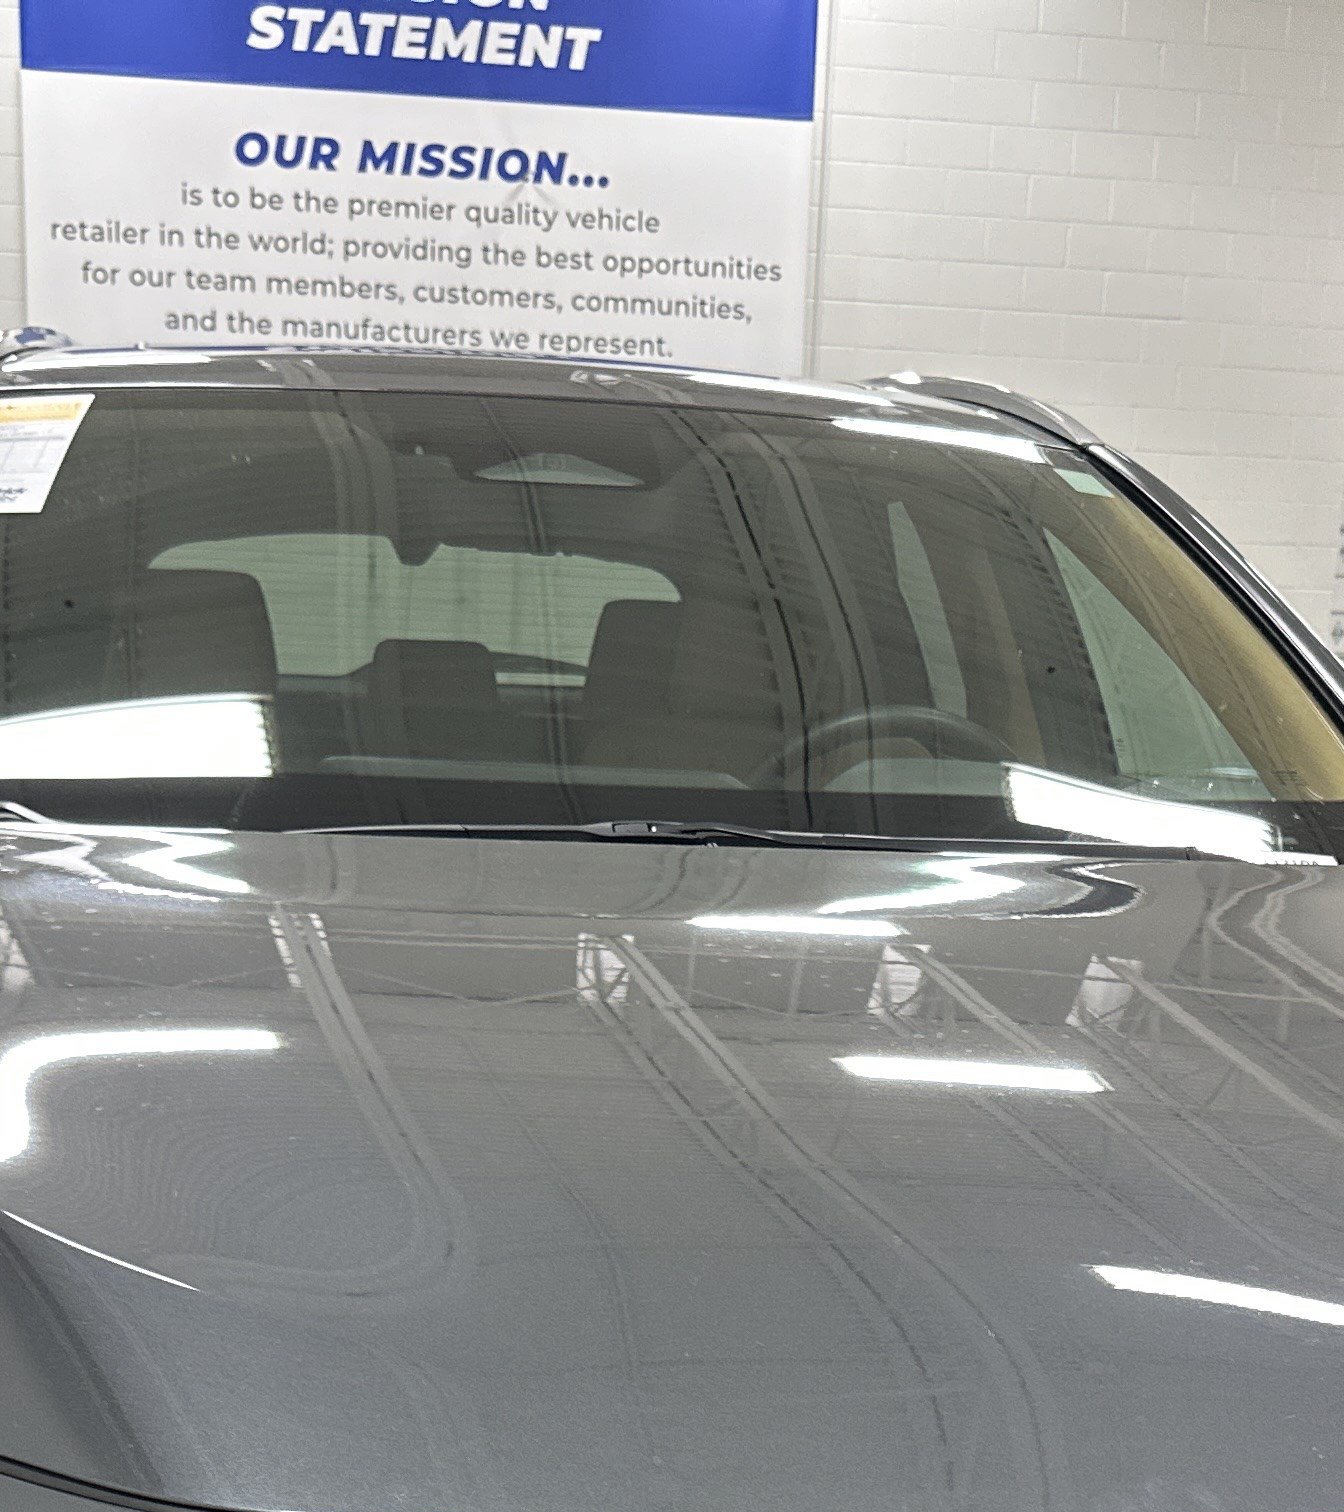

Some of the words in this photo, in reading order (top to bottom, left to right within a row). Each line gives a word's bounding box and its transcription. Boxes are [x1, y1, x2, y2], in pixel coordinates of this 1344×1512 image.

[246, 4, 603, 72] STATEMENT
[233, 131, 342, 173] OUR
[356, 138, 611, 189] MISSION...
[180, 181, 204, 207] is
[210, 186, 240, 209] to
[248, 185, 285, 212] be
[292, 189, 339, 215] the
[347, 195, 457, 226] premier
[463, 202, 559, 233] quality
[565, 207, 661, 234] vehicle
[50, 218, 151, 245] retailer
[158, 222, 185, 248] in
[193, 224, 241, 251] the
[247, 230, 335, 262] world;
[342, 236, 473, 270] providing
[480, 242, 527, 268] the
[535, 244, 595, 272] best
[601, 253, 783, 285] opportunities
[80, 259, 122, 286] for
[128, 268, 177, 291] our
[183, 268, 257, 294] team
[265, 275, 406, 306] members,
[412, 283, 564, 315] customers,
[570, 293, 753, 325] communities,
[164, 309, 217, 334] and
[225, 310, 274, 337] the
[281, 317, 482, 347] manufacturers
[489, 329, 530, 350] we
[538, 332, 674, 359] represent.
